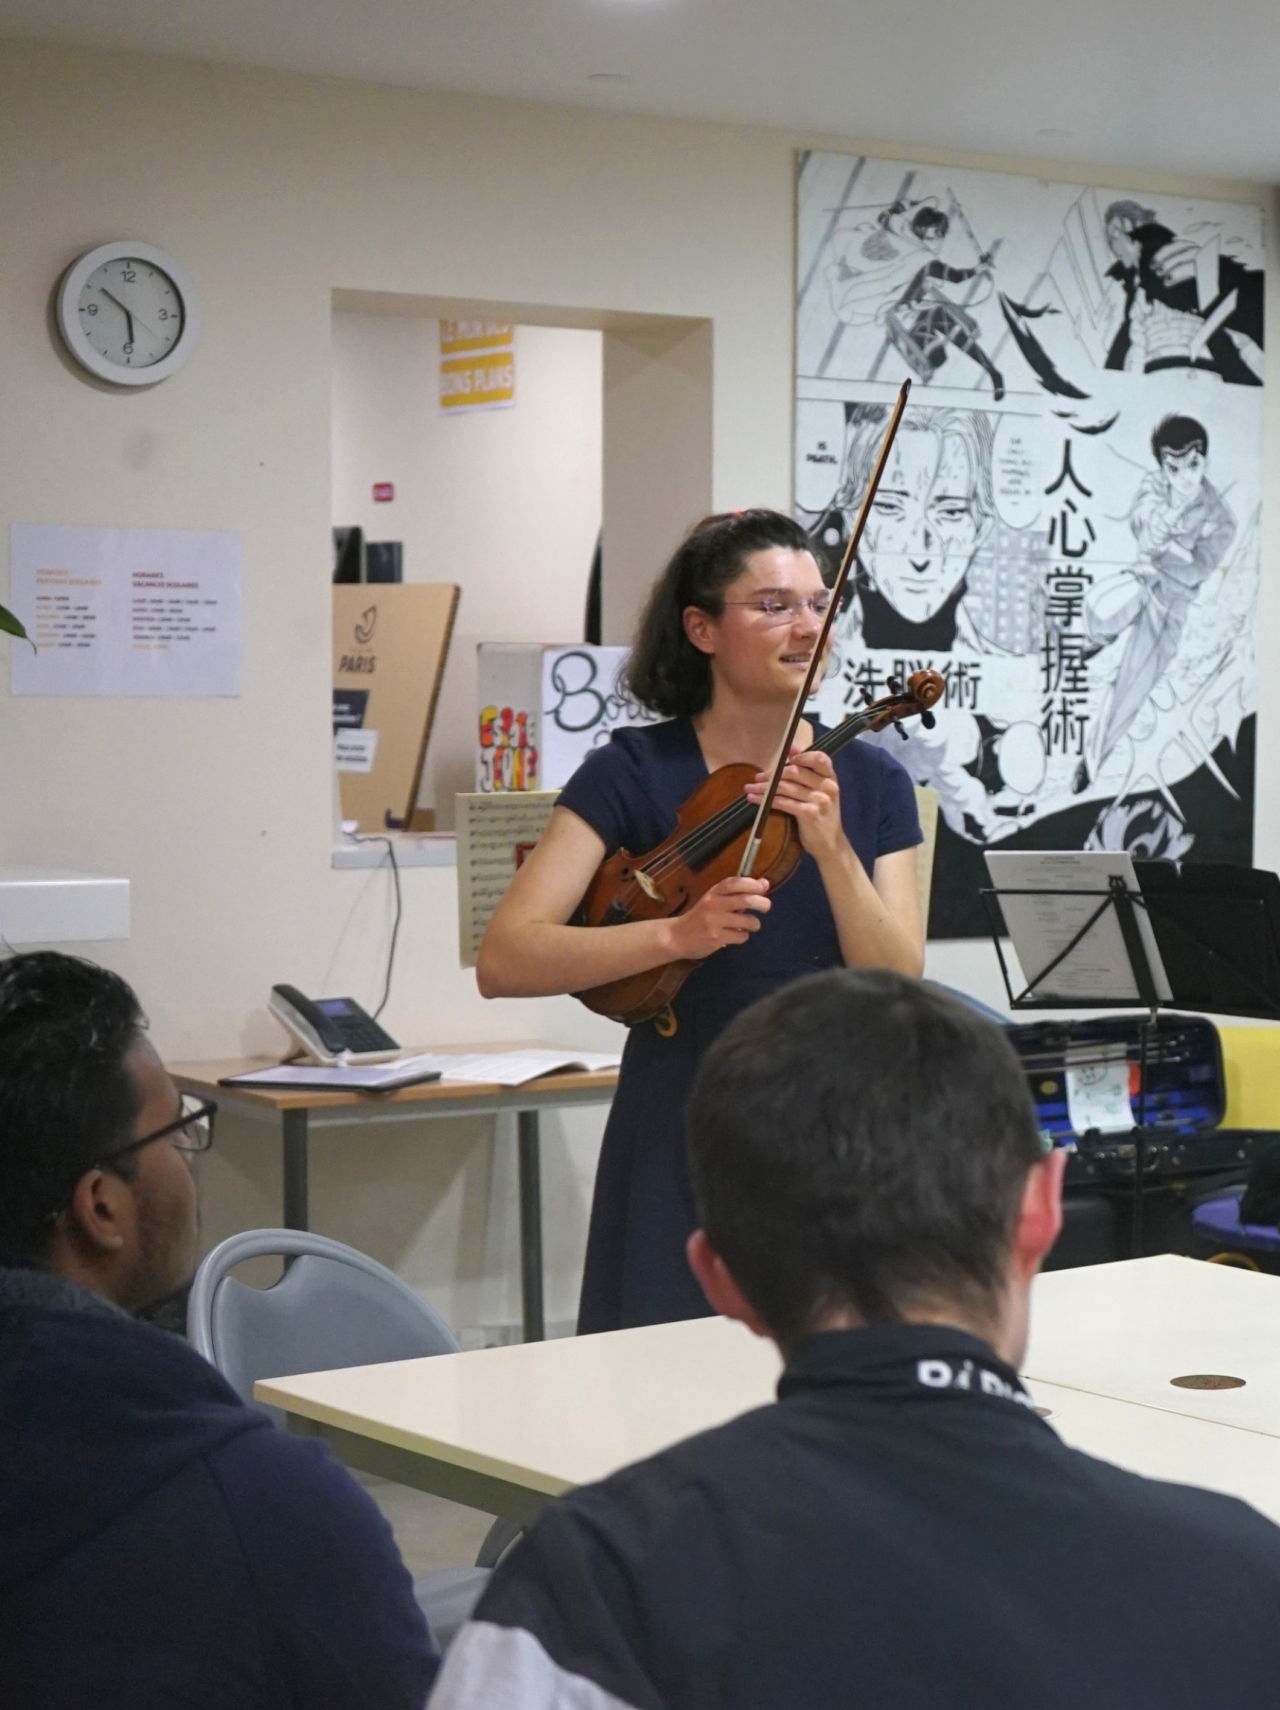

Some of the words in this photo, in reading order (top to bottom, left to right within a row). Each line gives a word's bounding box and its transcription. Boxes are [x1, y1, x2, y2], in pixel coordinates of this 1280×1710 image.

[120, 270, 136, 283] 12
[87, 303, 98, 316] 9
[158, 308, 168, 321] 3
[123, 342, 134, 355] 6
[1040, 437, 1097, 757] 人心掌握術
[339, 654, 377, 674] PARIS
